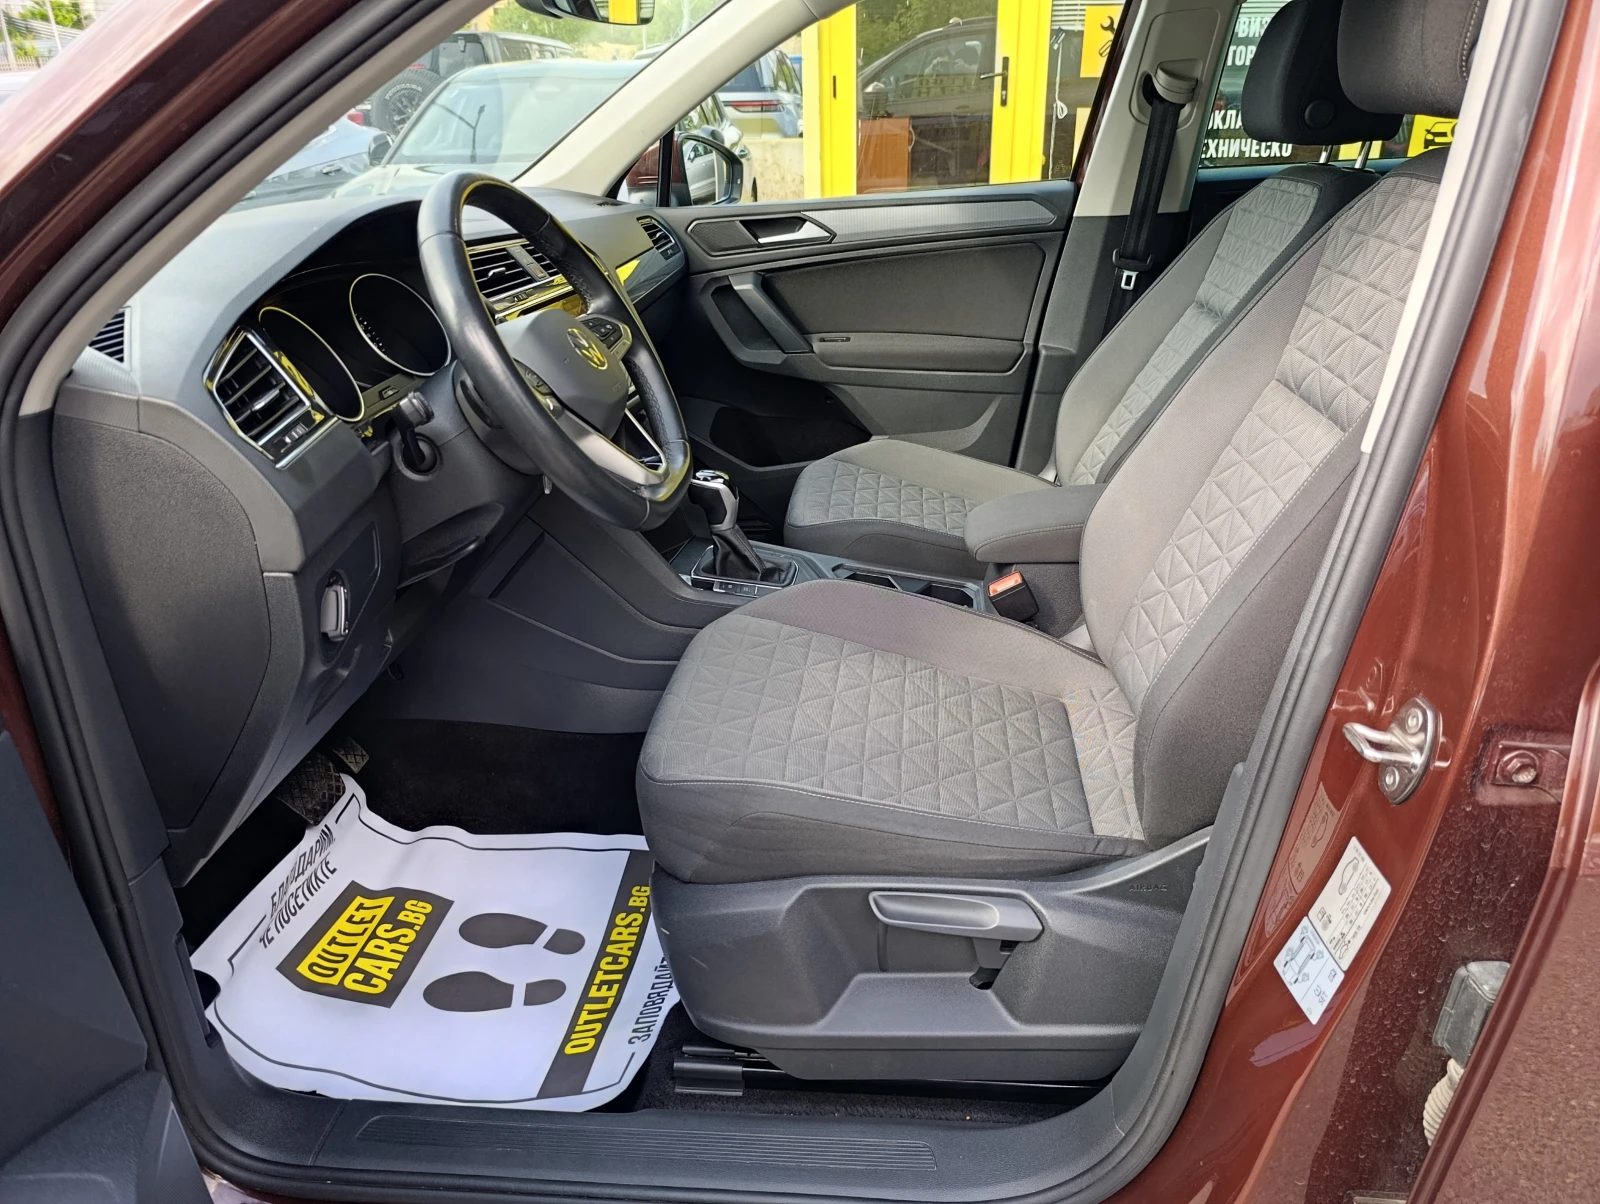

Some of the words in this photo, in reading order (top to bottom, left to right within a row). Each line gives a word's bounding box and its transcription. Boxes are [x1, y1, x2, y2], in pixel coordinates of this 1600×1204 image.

[308, 902, 385, 978] OUTLET
[343, 899, 433, 994] CARS.BG
[564, 885, 650, 1055] OUTLETCARS.BG
